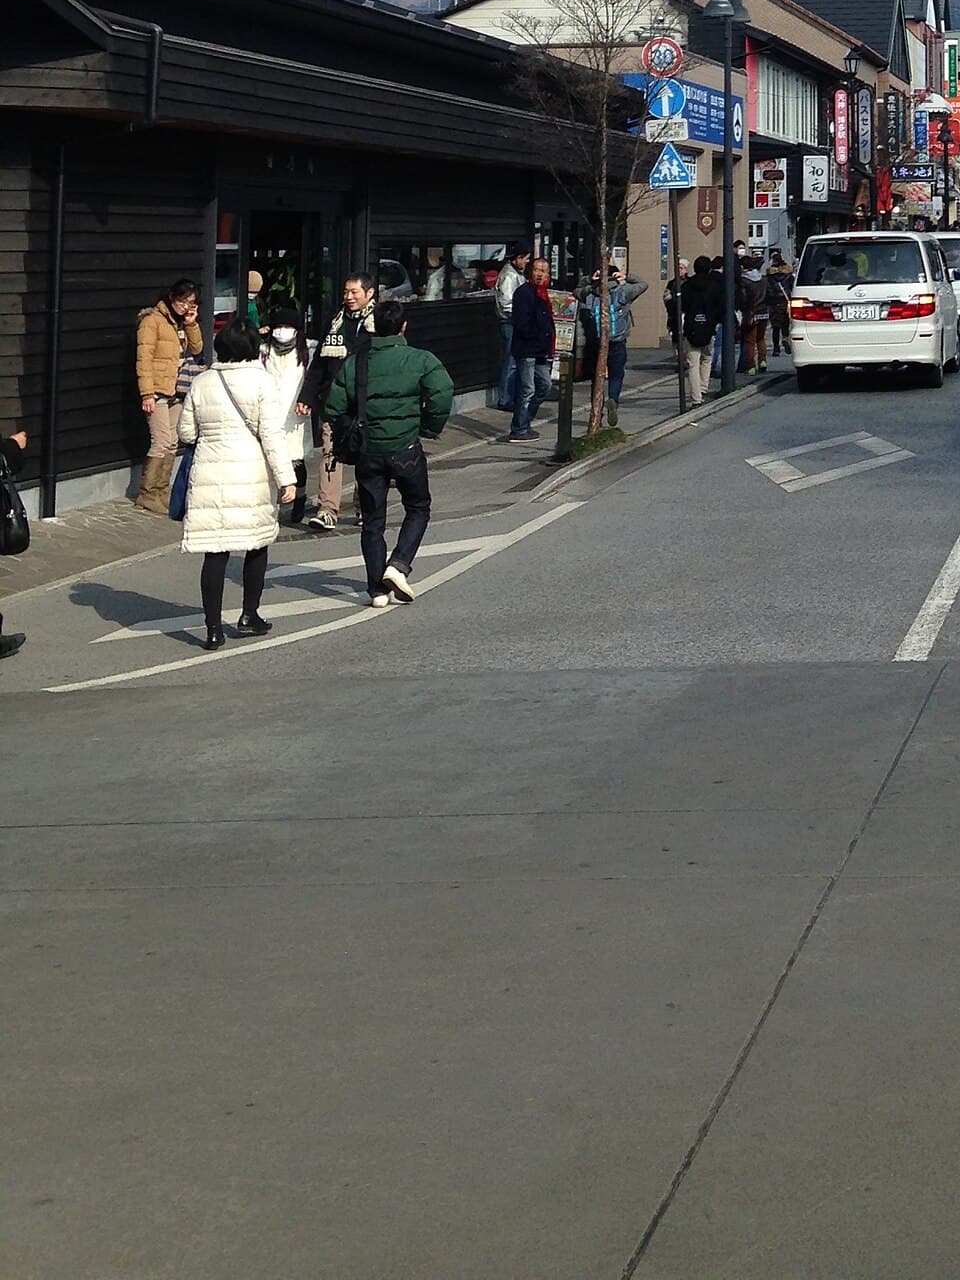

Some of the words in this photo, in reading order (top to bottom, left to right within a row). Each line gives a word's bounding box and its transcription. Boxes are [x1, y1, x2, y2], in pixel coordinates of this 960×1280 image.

[860, 95, 869, 159] バスセンター
[323, 335, 344, 346] 969
